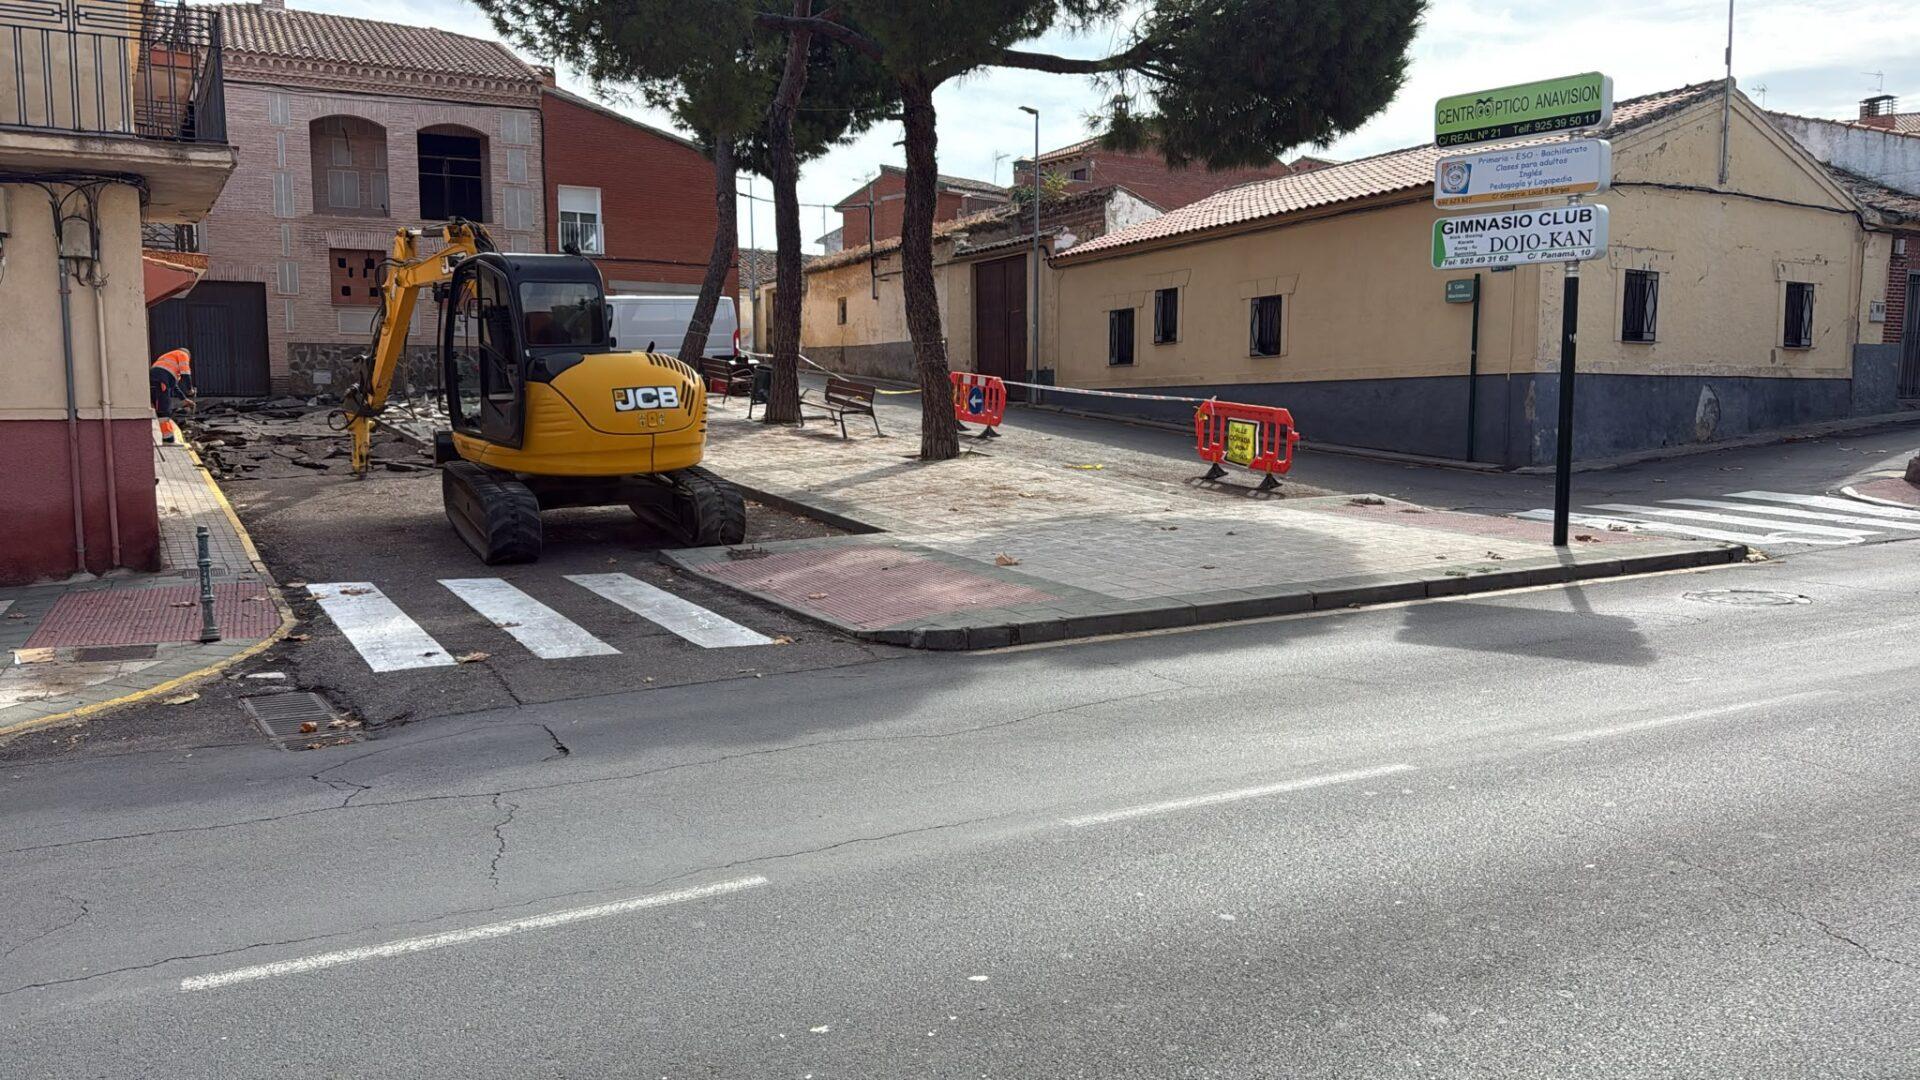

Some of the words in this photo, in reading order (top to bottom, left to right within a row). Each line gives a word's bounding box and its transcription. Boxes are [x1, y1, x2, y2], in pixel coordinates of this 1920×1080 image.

[1535, 86, 1600, 109] ANAVISION
[1439, 134, 1450, 145] C/
[1451, 131, 1475, 144] REAL
[1491, 128, 1501, 138] 21
[1534, 121, 1553, 132] 925
[1554, 118, 1567, 128] 39
[1570, 116, 1582, 126] 50
[1585, 114, 1596, 123] 11
[1478, 155, 1509, 164] Primaria
[1516, 151, 1534, 160] ESO
[1541, 146, 1588, 157] Bachillerato
[1496, 162, 1519, 172] Clases
[1521, 161, 1538, 169] para
[1540, 157, 1568, 167] adultos
[1442, 214, 1533, 235] GIMNASIO
[1539, 209, 1592, 226] CLUB
[1490, 229, 1593, 254] DOJO-KAN
[1528, 252, 1537, 260] C/
[1541, 251, 1577, 259] Panamá,
[615, 387, 679, 411] JCB
